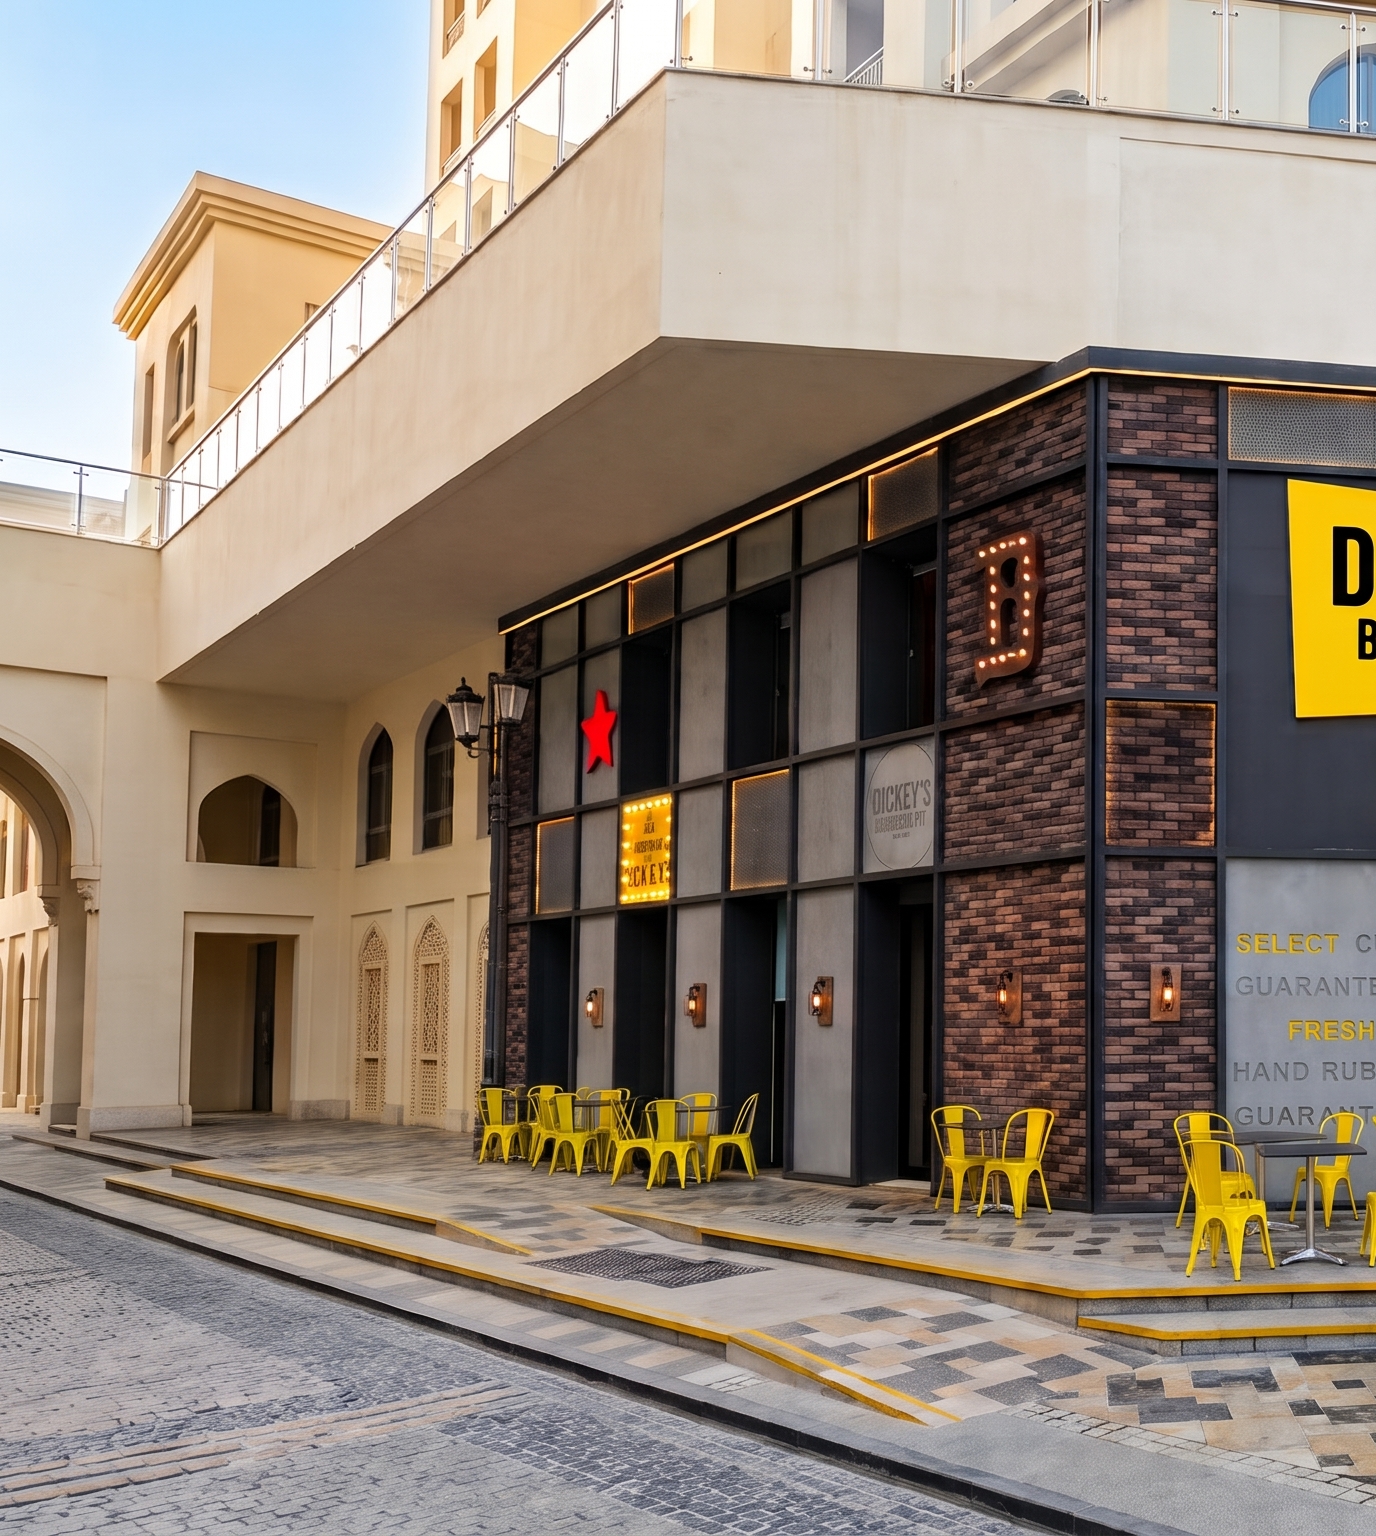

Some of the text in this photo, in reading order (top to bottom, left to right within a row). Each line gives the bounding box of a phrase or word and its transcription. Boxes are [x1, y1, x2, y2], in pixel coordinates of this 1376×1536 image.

[872, 779, 932, 815] DICKEY'S
[1236, 933, 1340, 954] SELECT
[1288, 1020, 1375, 1041] FRESH
[1233, 1061, 1309, 1082] HAND
